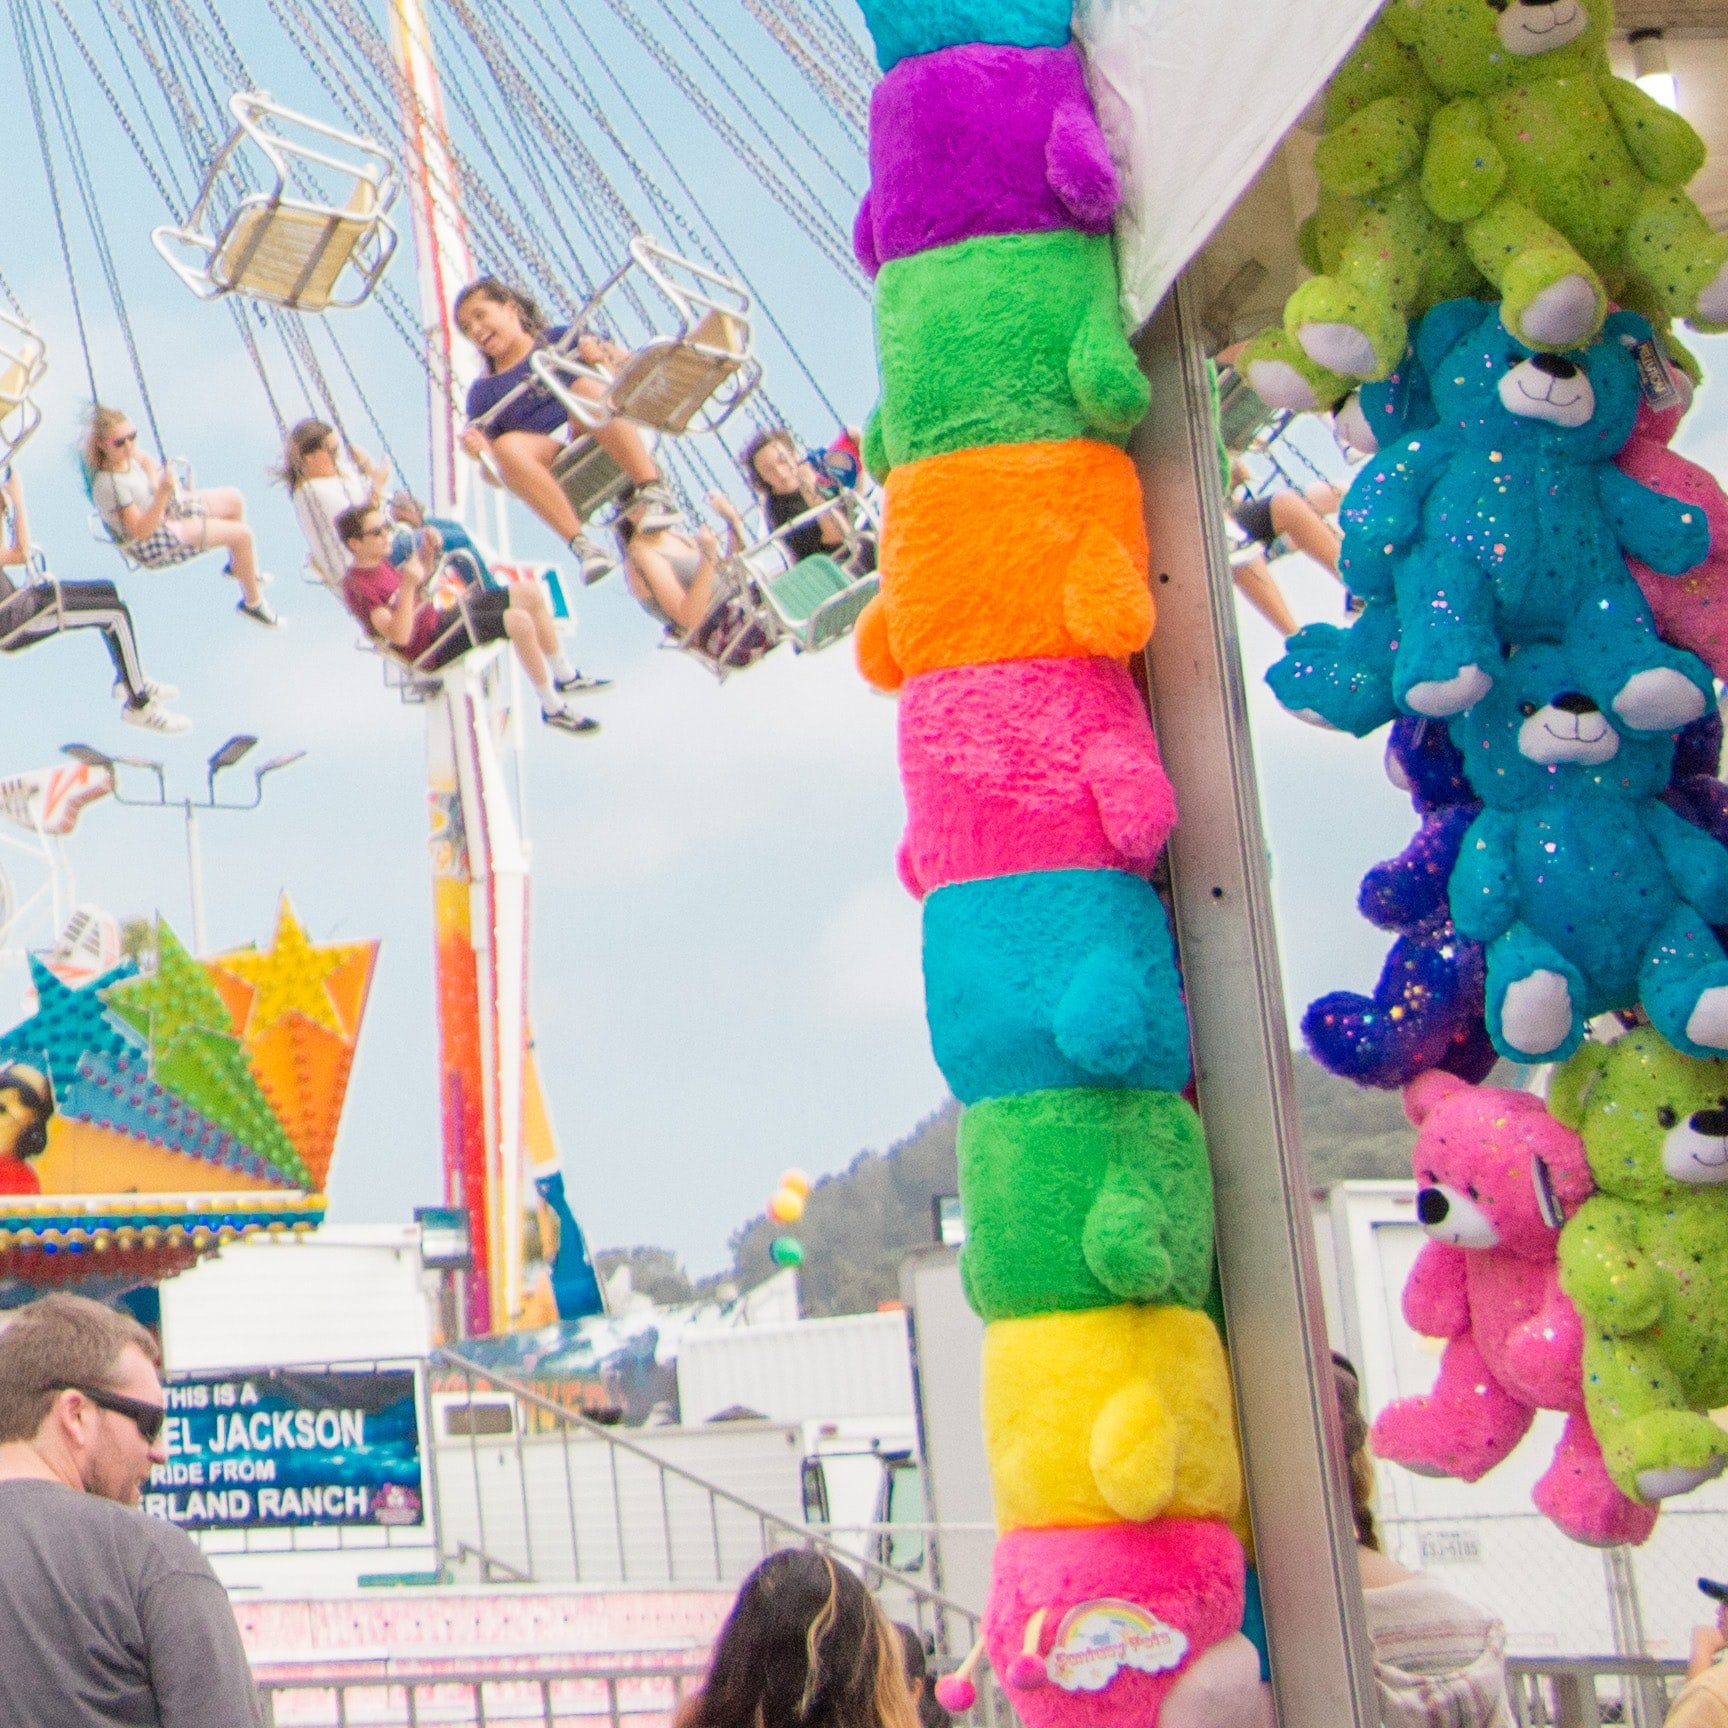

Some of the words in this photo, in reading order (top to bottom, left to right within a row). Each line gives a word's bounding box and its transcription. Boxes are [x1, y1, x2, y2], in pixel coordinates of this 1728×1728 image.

[163, 1384, 208, 1410] THIS
[213, 1383, 235, 1407] IS
[239, 1380, 259, 1406] A
[208, 1409, 366, 1454] JACKSON
[150, 1461, 205, 1487] RIDE
[208, 1458, 277, 1484] FROM
[257, 1485, 369, 1520] RANCH
